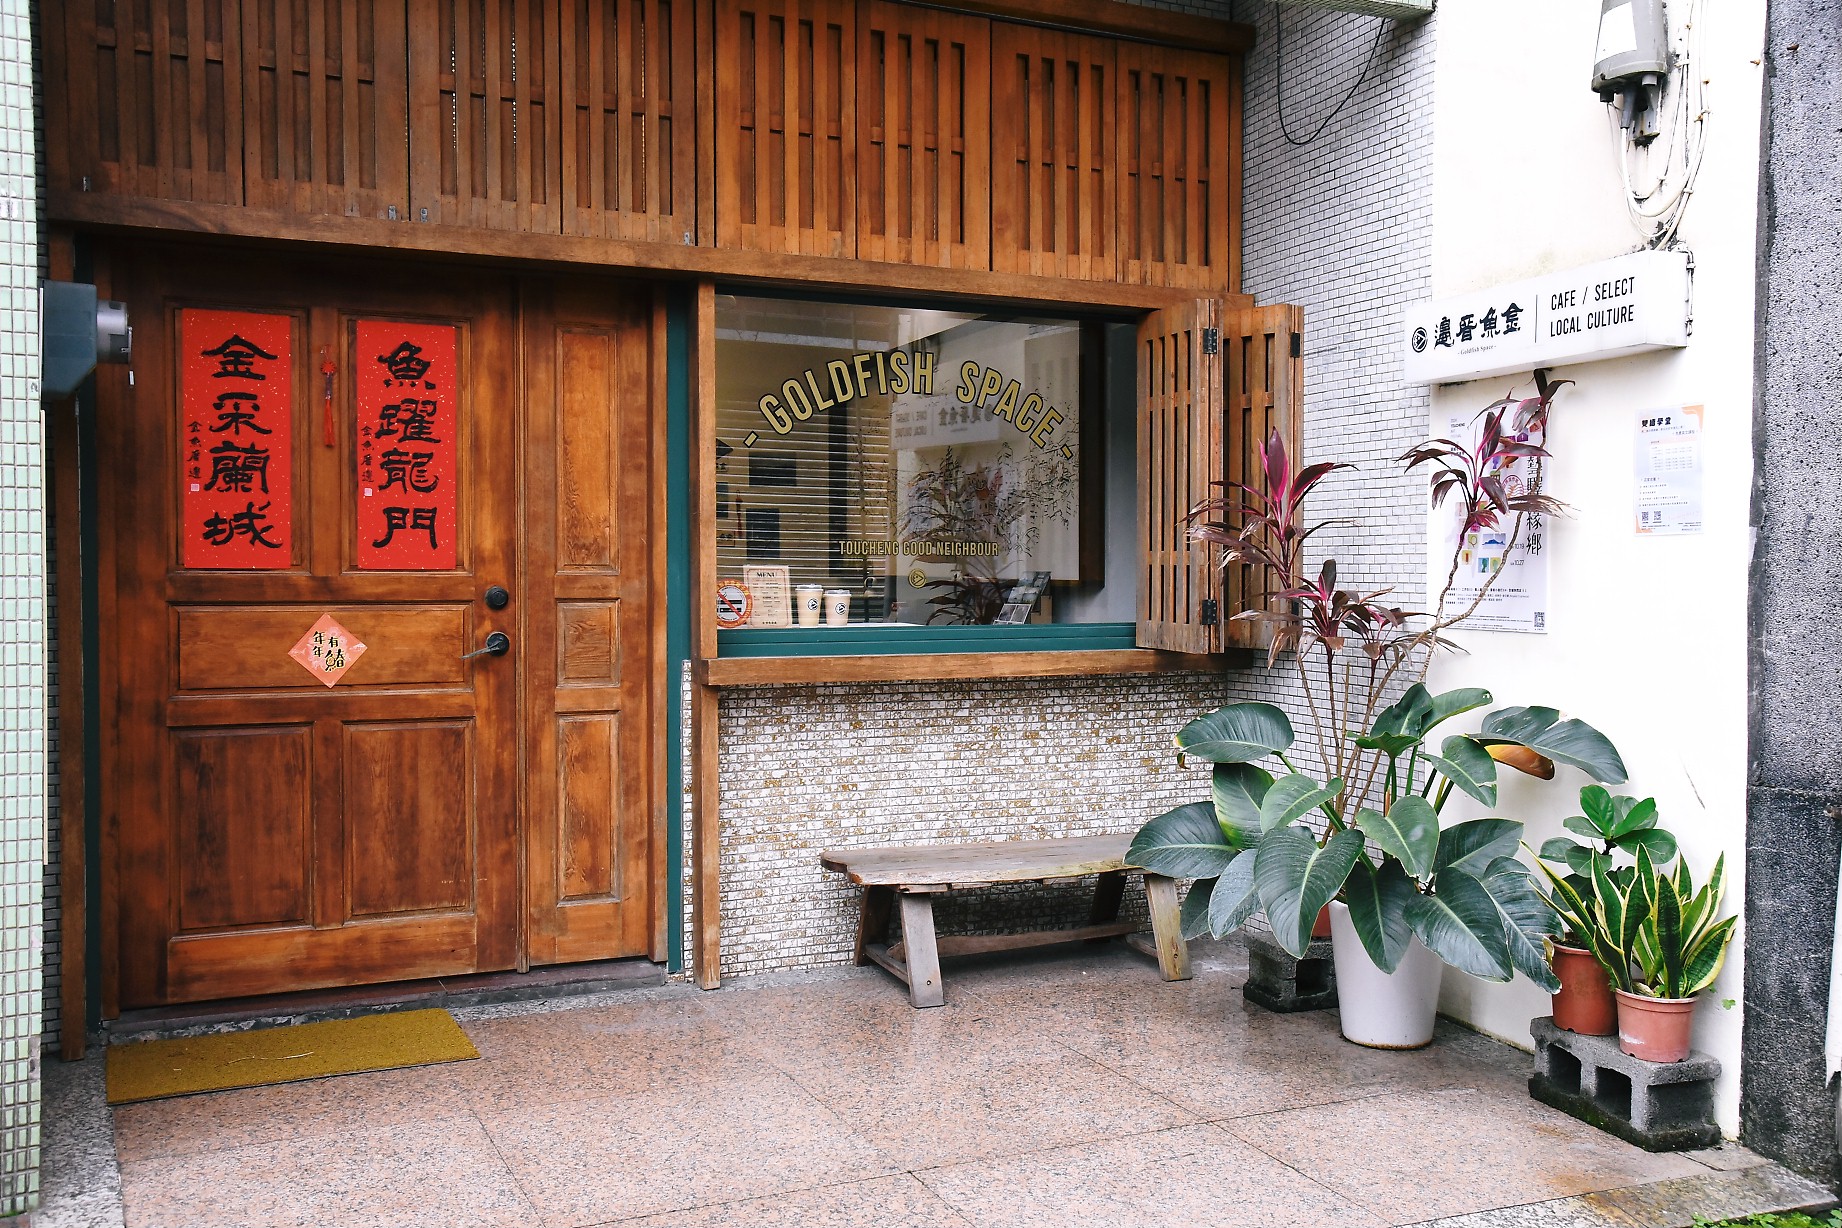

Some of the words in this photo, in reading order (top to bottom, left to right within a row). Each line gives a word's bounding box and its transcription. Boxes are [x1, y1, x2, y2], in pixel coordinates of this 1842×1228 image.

[1551, 290, 1576, 311] CAFE
[1594, 277, 1635, 301] SELECT
[1550, 316, 1582, 337] LOCAL
[1587, 305, 1635, 330] CULTURE
[1480, 345, 1494, 353] Space
[758, 350, 935, 435] GOLDFISH
[956, 360, 1065, 449] SPACE
[372, 340, 441, 551] 魚躍龍門
[839, 541, 899, 556] TOUCHENG
[903, 541, 934, 557] GOOD
[936, 541, 999, 557] NEIGHBOUR
